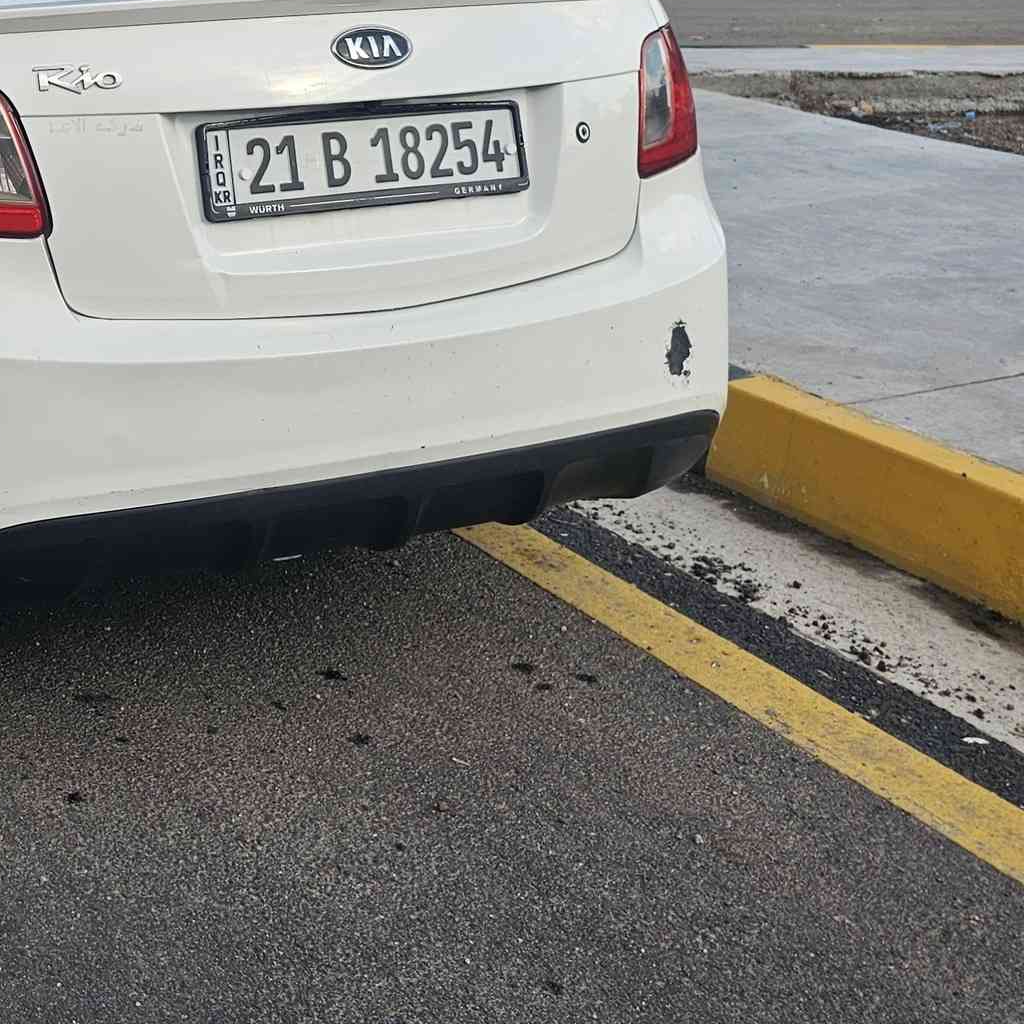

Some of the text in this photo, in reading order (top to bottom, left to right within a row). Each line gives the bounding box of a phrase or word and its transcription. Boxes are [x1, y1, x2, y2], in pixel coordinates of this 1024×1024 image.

[345, 35, 402, 59] KIA
[32, 64, 122, 95] Rio
[246, 119, 506, 195] 21 B 18254
[214, 190, 231, 204] KR
